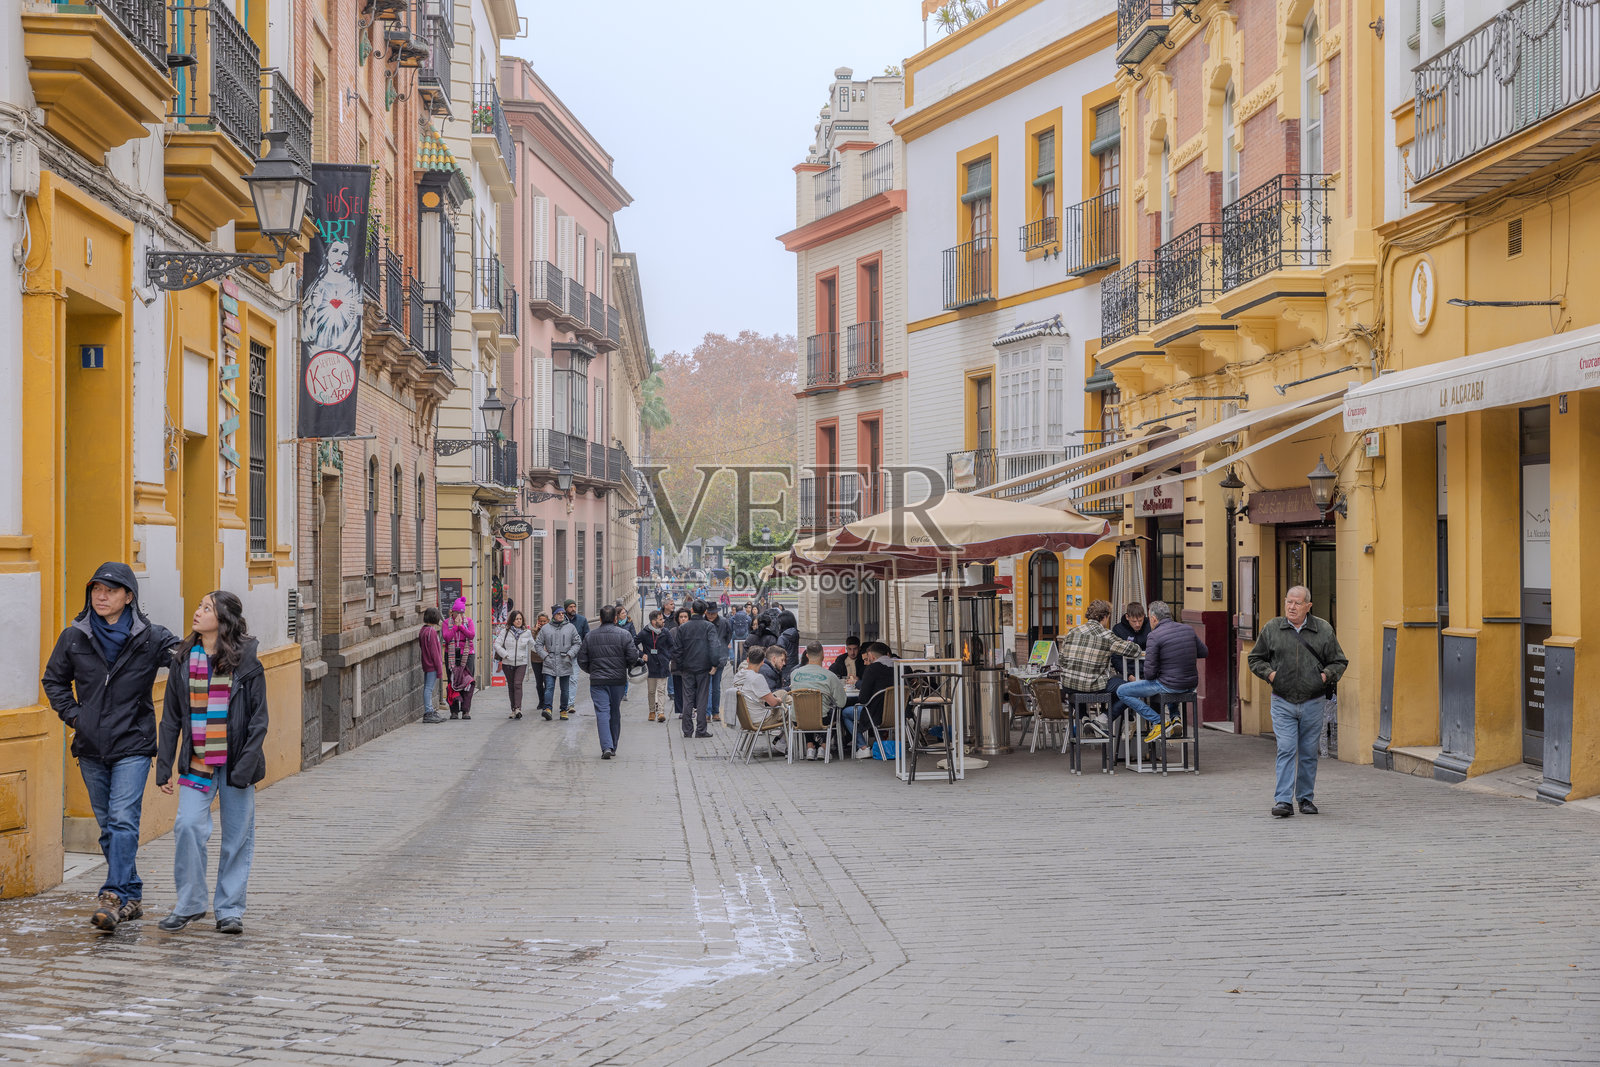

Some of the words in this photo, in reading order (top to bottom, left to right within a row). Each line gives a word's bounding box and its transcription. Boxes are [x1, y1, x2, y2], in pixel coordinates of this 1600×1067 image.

[315, 217, 356, 244] ART
[87, 348, 96, 368] 1
[330, 388, 351, 401] ART
[1440, 386, 1448, 408] LA
[1451, 380, 1485, 405] ALCAZABA
[910, 535, 931, 543] Coca-Cola
